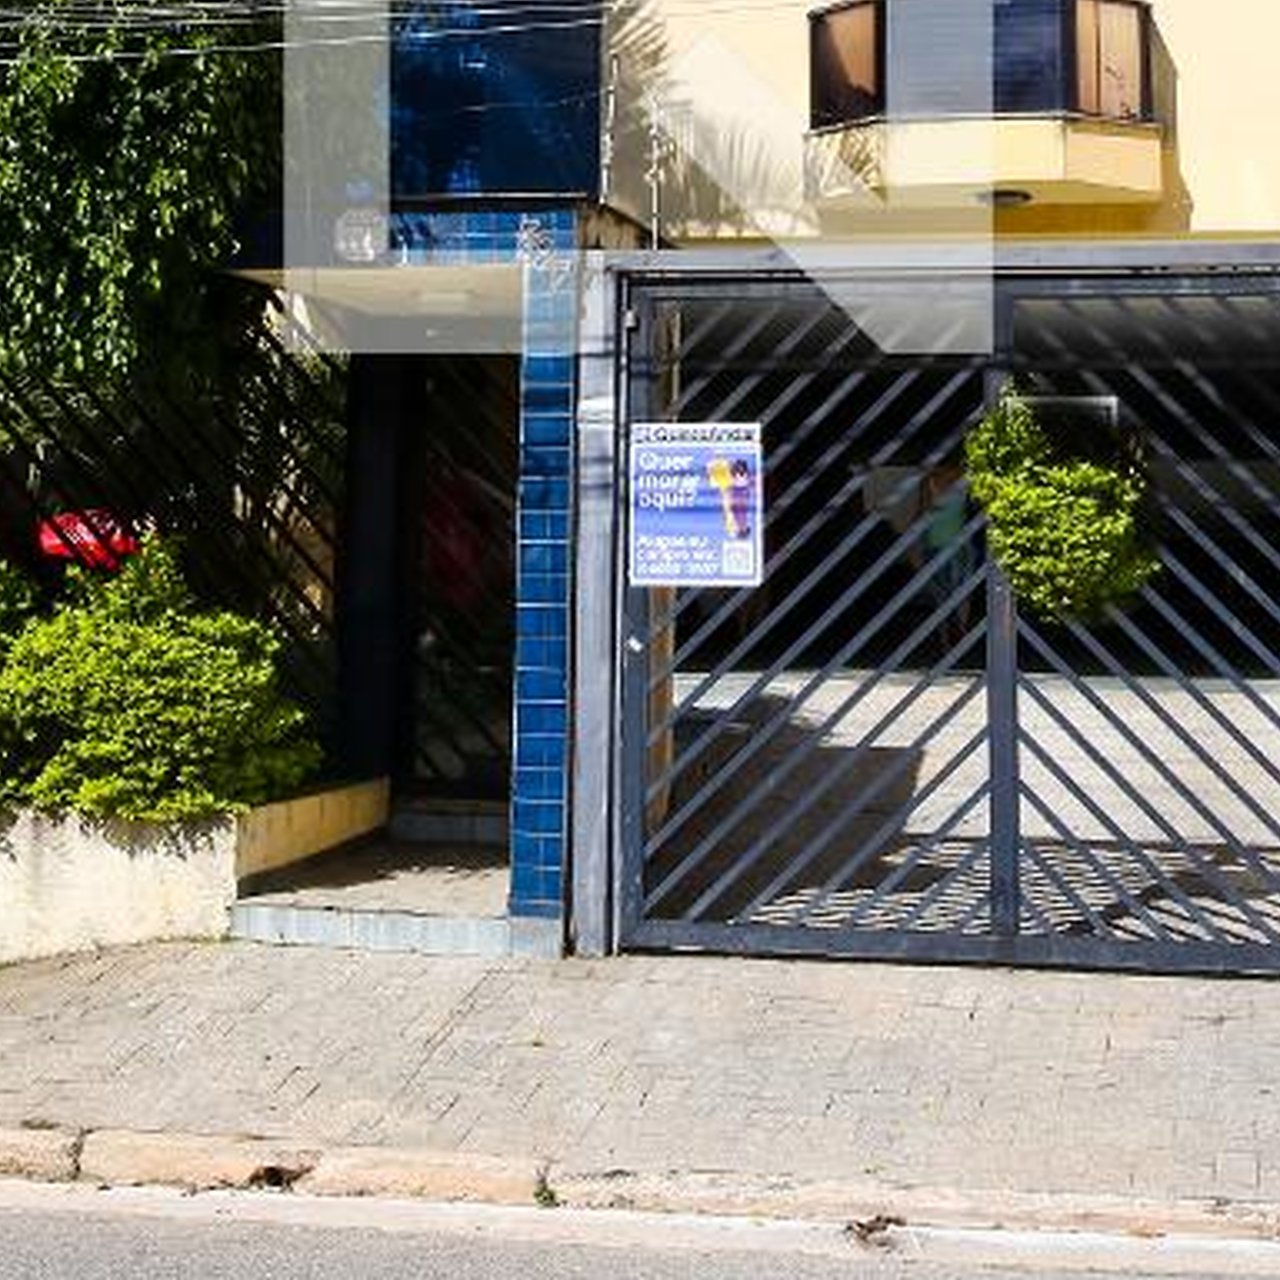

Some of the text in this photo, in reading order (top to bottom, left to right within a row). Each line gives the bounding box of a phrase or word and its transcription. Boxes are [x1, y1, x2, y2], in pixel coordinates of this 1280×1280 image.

[638, 451, 694, 470] Quer
[638, 474, 700, 488] morar
[639, 490, 697, 511] aqui?
